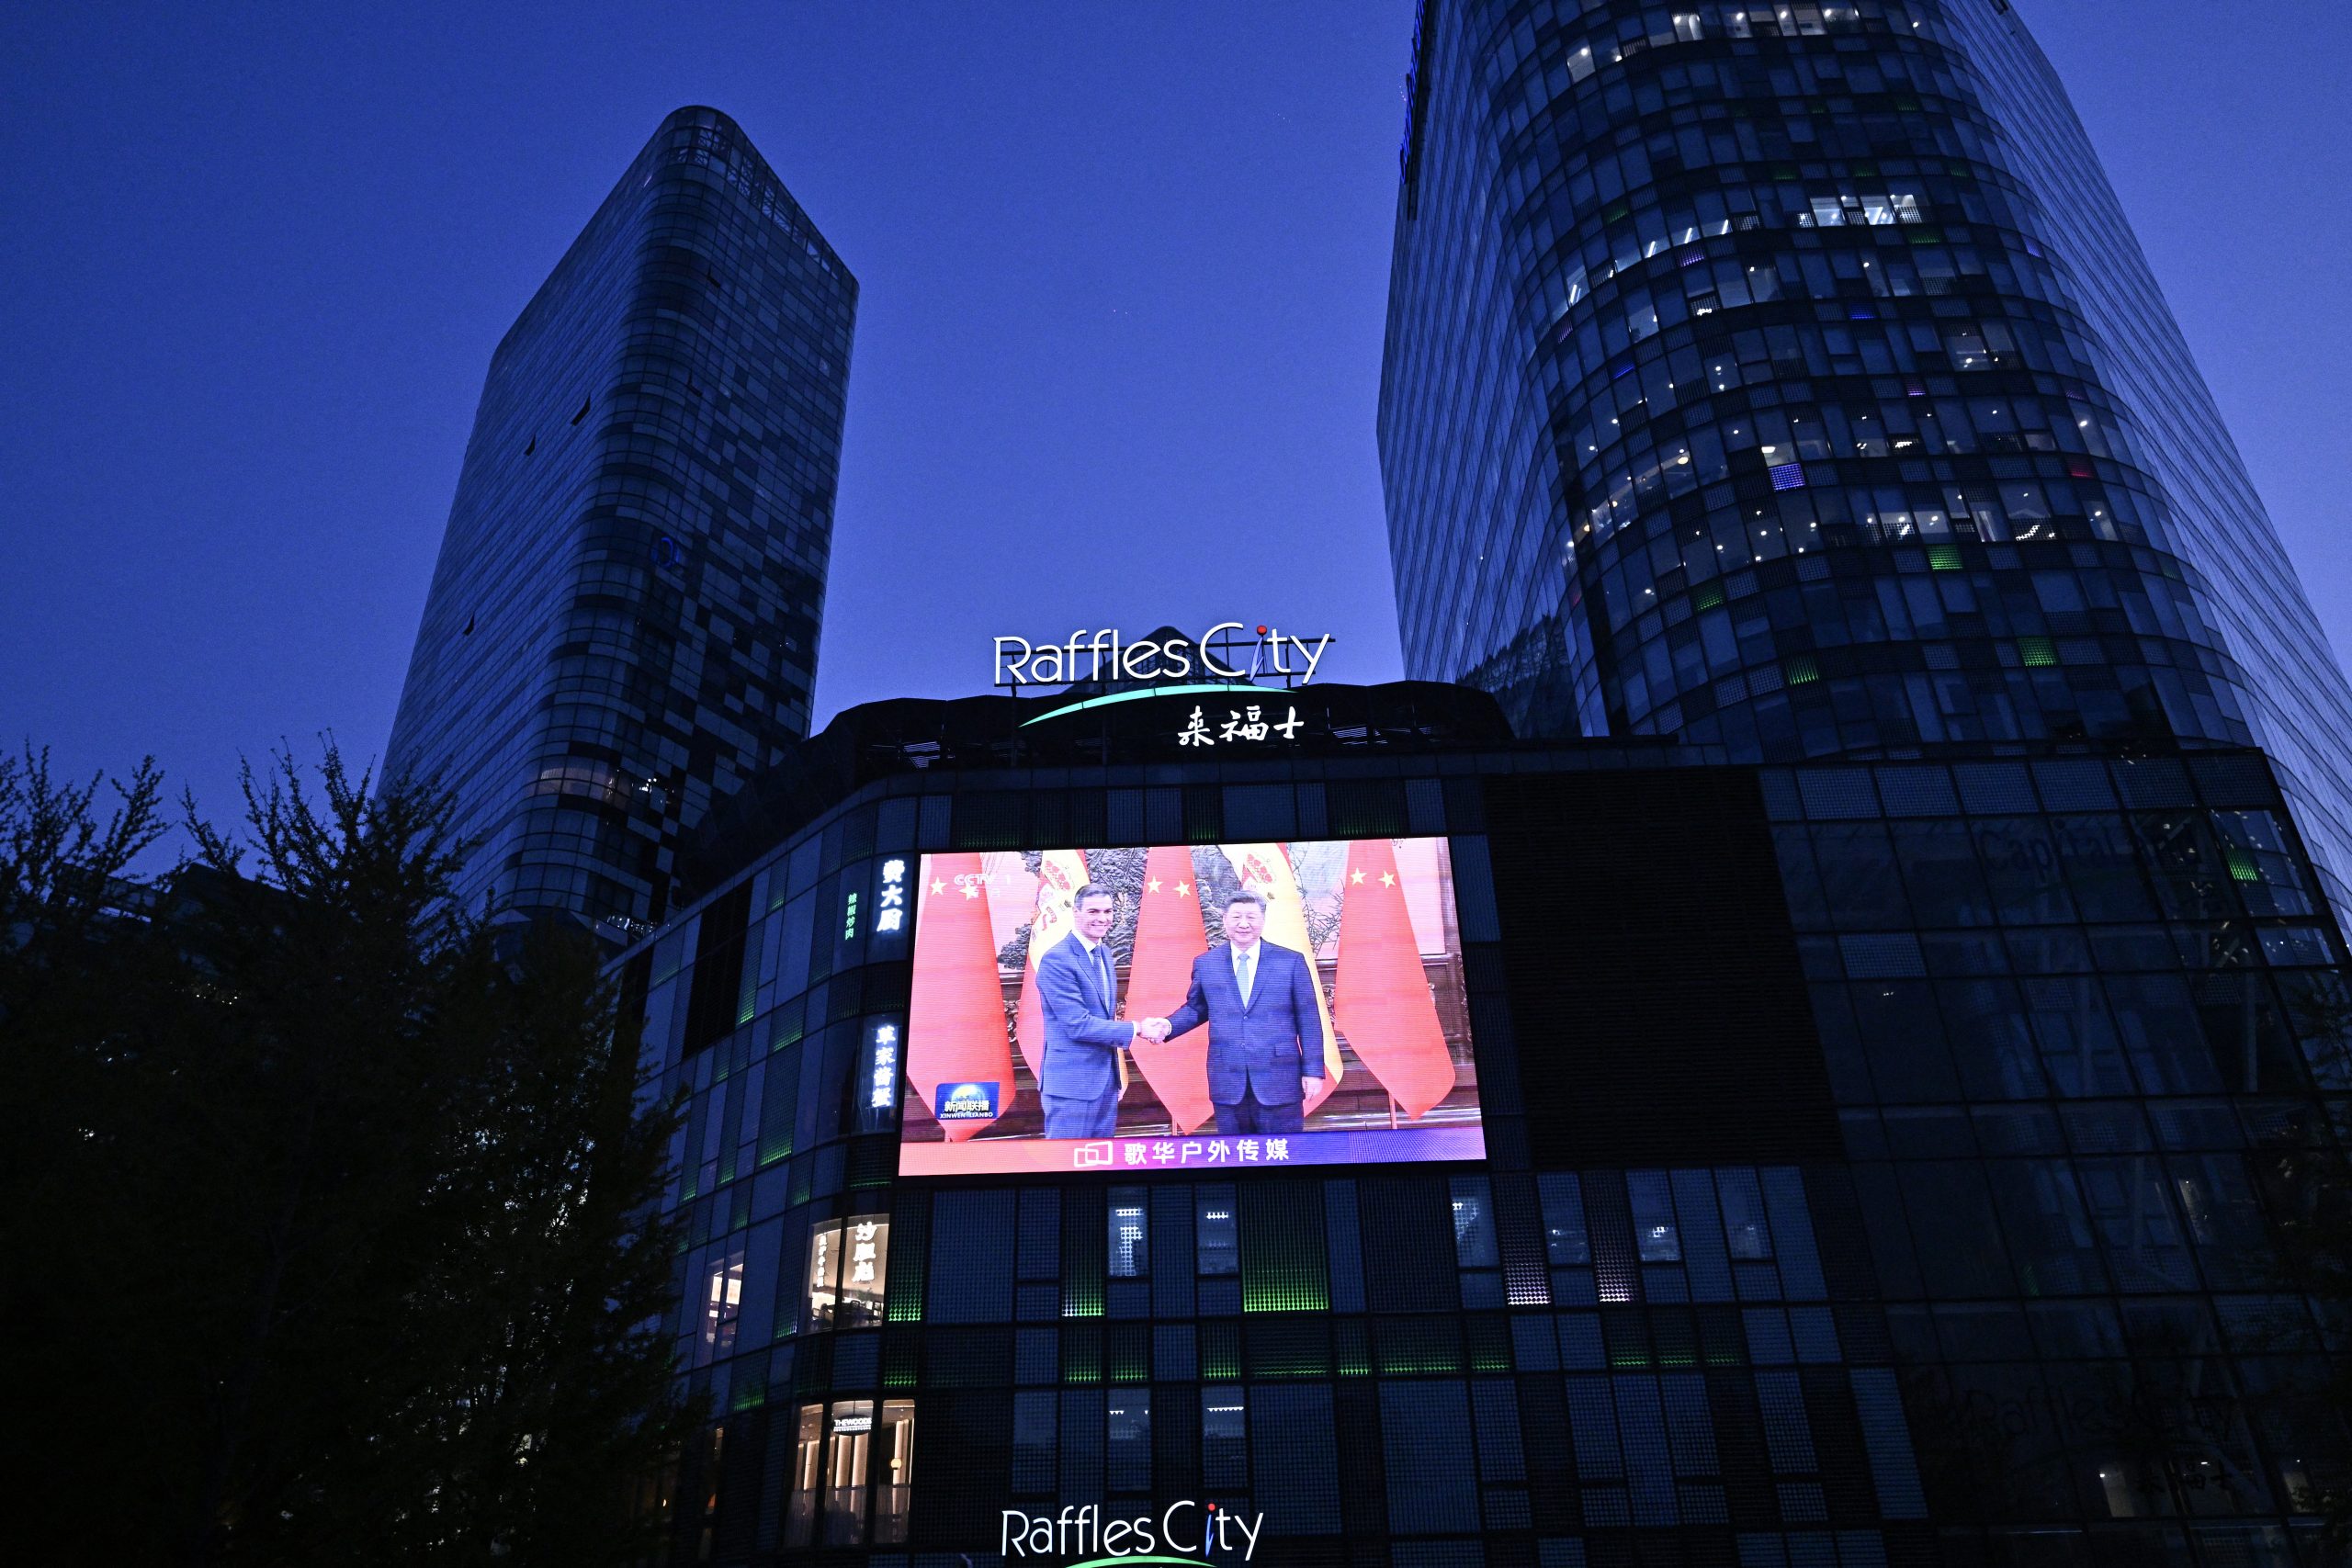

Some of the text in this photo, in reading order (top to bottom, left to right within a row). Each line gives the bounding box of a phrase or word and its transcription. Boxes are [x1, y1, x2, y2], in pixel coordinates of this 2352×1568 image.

[992, 622, 1330, 685] Raffles City
[1178, 705, 1305, 747] 来福士
[944, 1100, 989, 1112] 新闻联播
[1125, 1138, 1290, 1166] 歌华户外传媒
[1001, 1500, 1263, 1561] Raffles City
